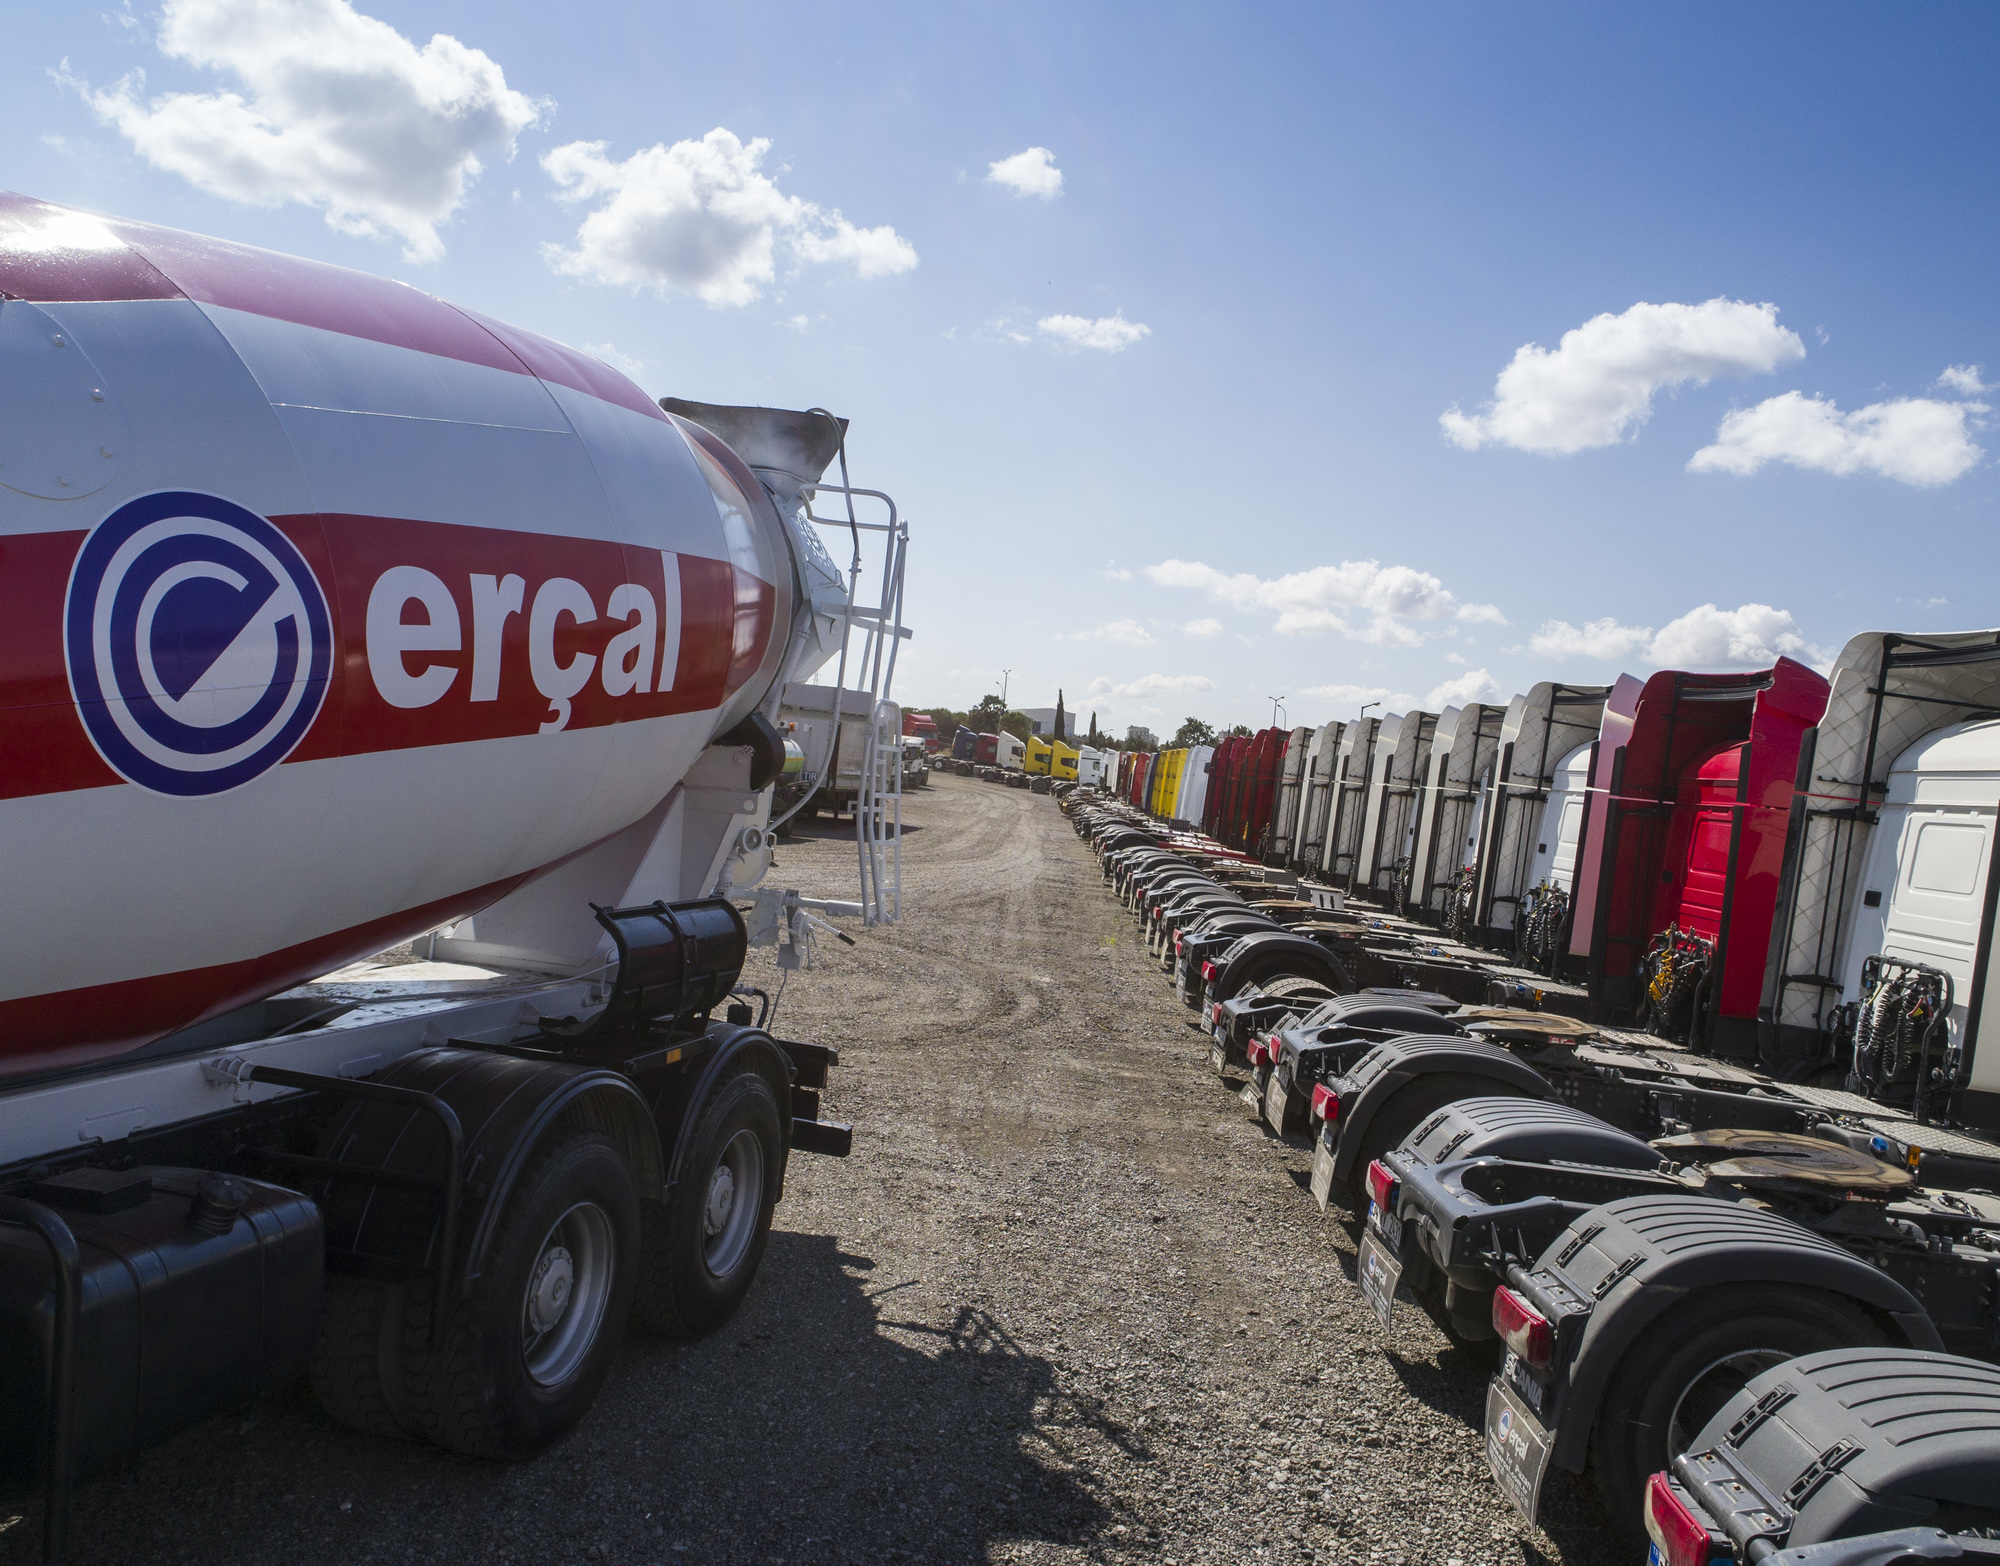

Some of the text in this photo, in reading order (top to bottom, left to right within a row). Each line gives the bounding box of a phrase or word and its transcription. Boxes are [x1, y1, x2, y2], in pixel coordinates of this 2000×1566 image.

[366, 551, 682, 735] erçal
[803, 771, 817, 781] TIR
[1504, 1353, 1543, 1414] SCANIA
[1508, 1428, 1530, 1461] erçal
